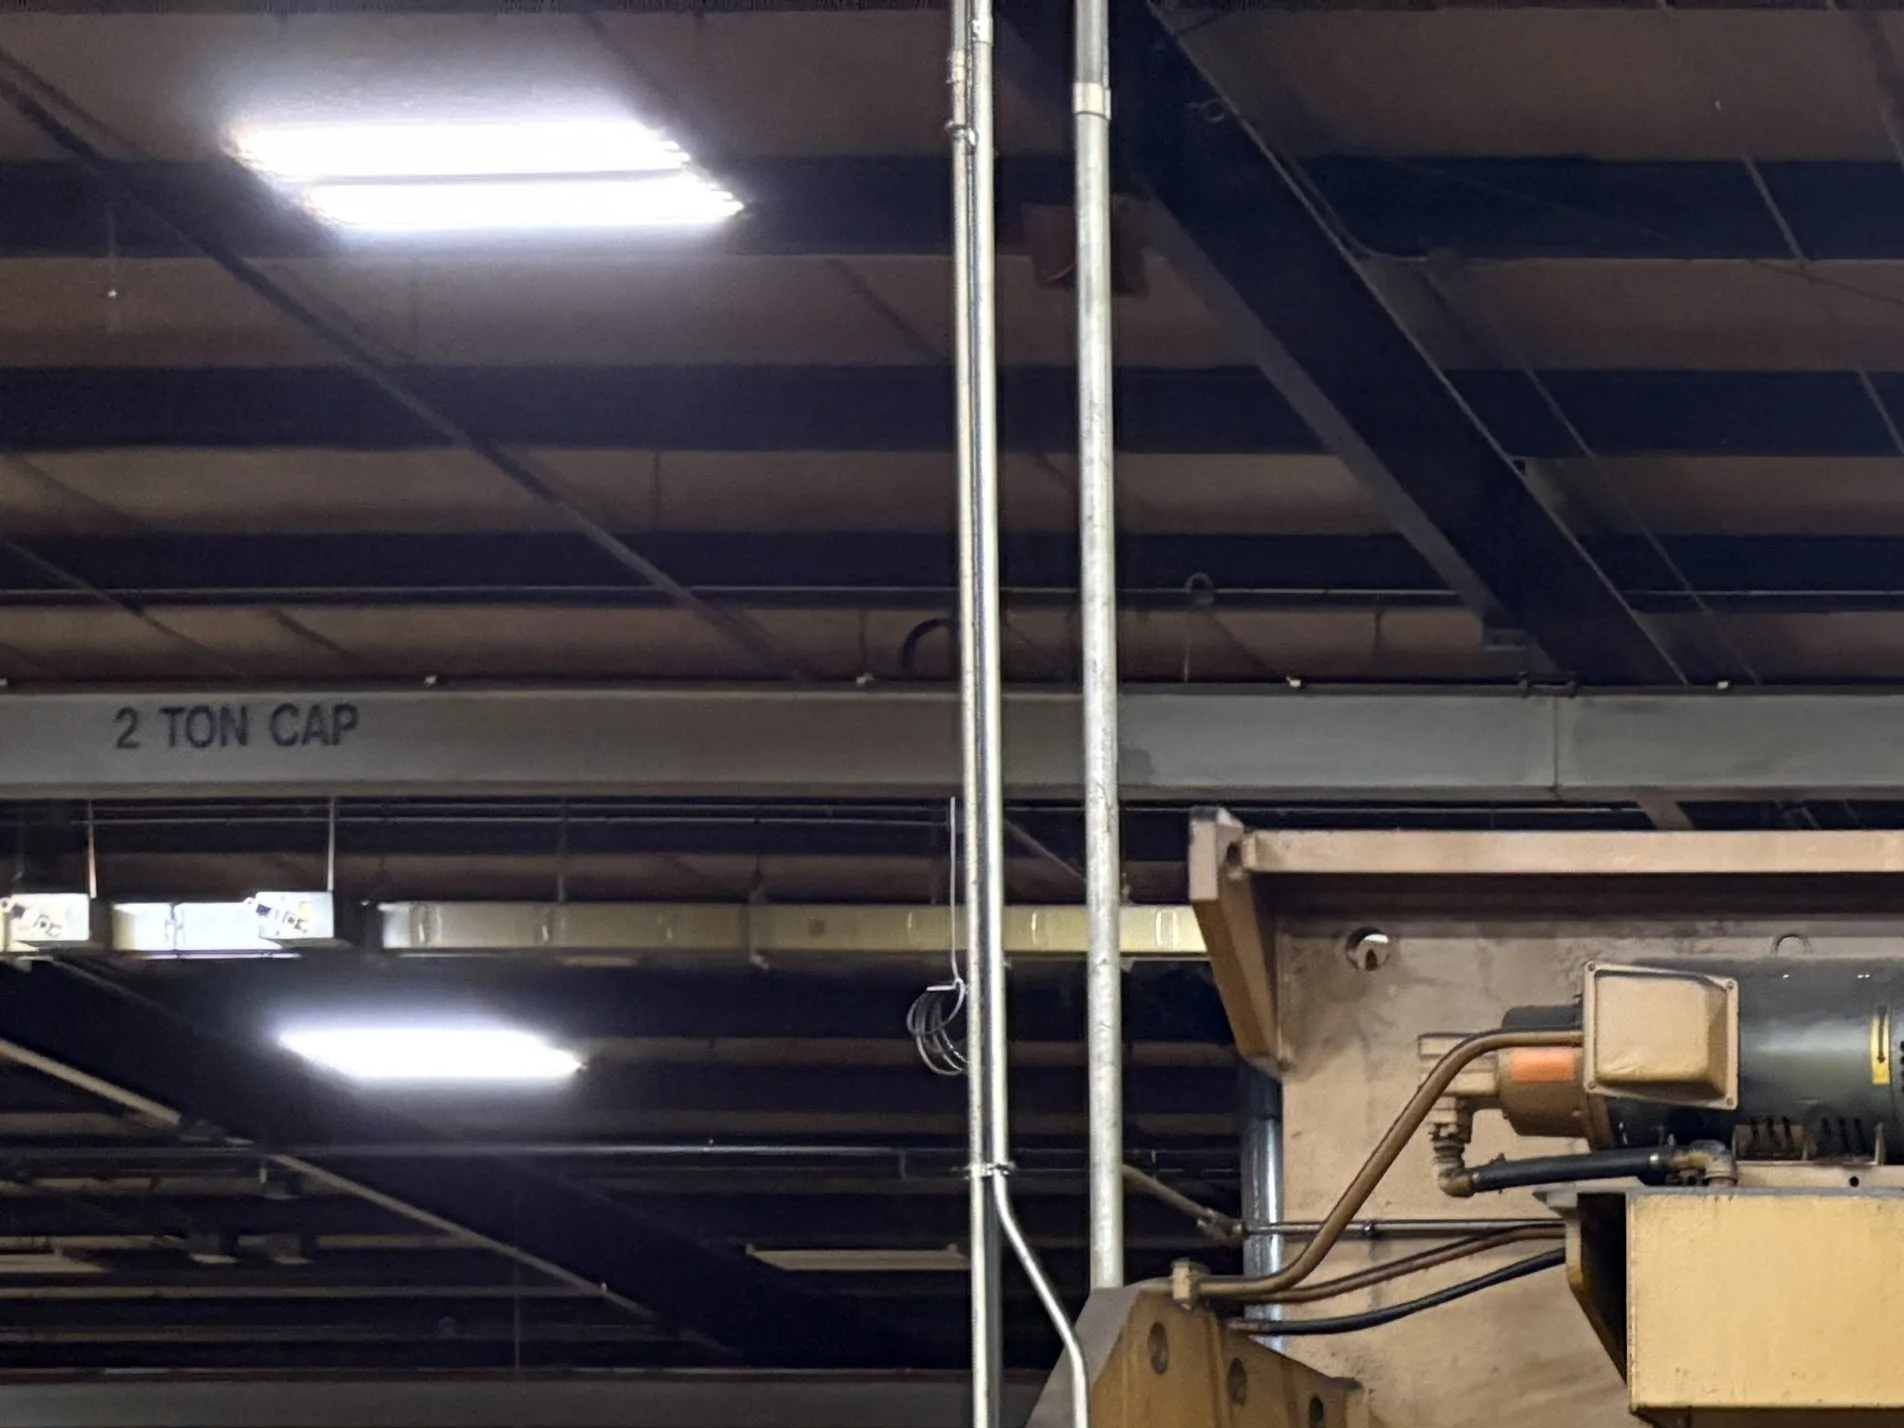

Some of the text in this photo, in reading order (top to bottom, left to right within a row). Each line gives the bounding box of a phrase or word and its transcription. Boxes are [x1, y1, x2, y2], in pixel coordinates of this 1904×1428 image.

[113, 702, 360, 750] 2 TON CAP
